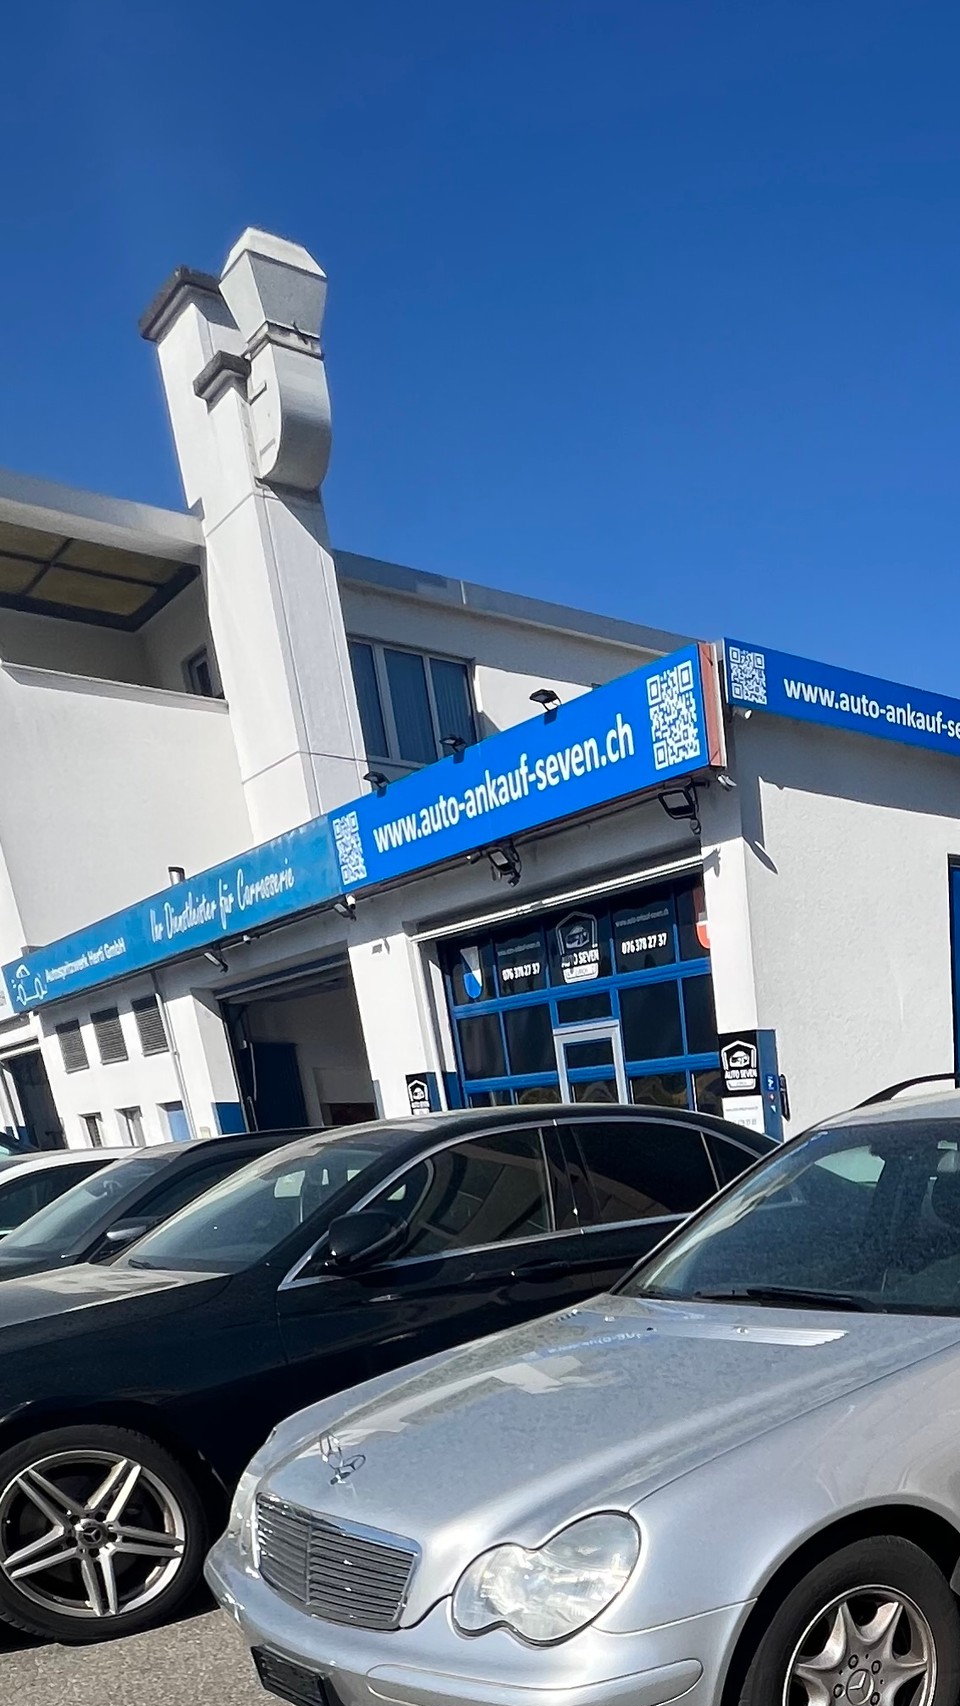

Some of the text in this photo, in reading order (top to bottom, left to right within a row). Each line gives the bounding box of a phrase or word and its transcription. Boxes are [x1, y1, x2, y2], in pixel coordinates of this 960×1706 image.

[372, 713, 635, 853] www.auto-ankauf-seven.ch
[150, 858, 295, 942] Ihr Dienstleister für Carrosserie
[104, 937, 126, 960] GmbH
[621, 941, 635, 954] 076
[647, 934, 657, 949] 27
[658, 932, 667, 947] 37
[578, 949, 600, 965] SEVEN
[725, 1068, 757, 1079] AUTO SEVEN
